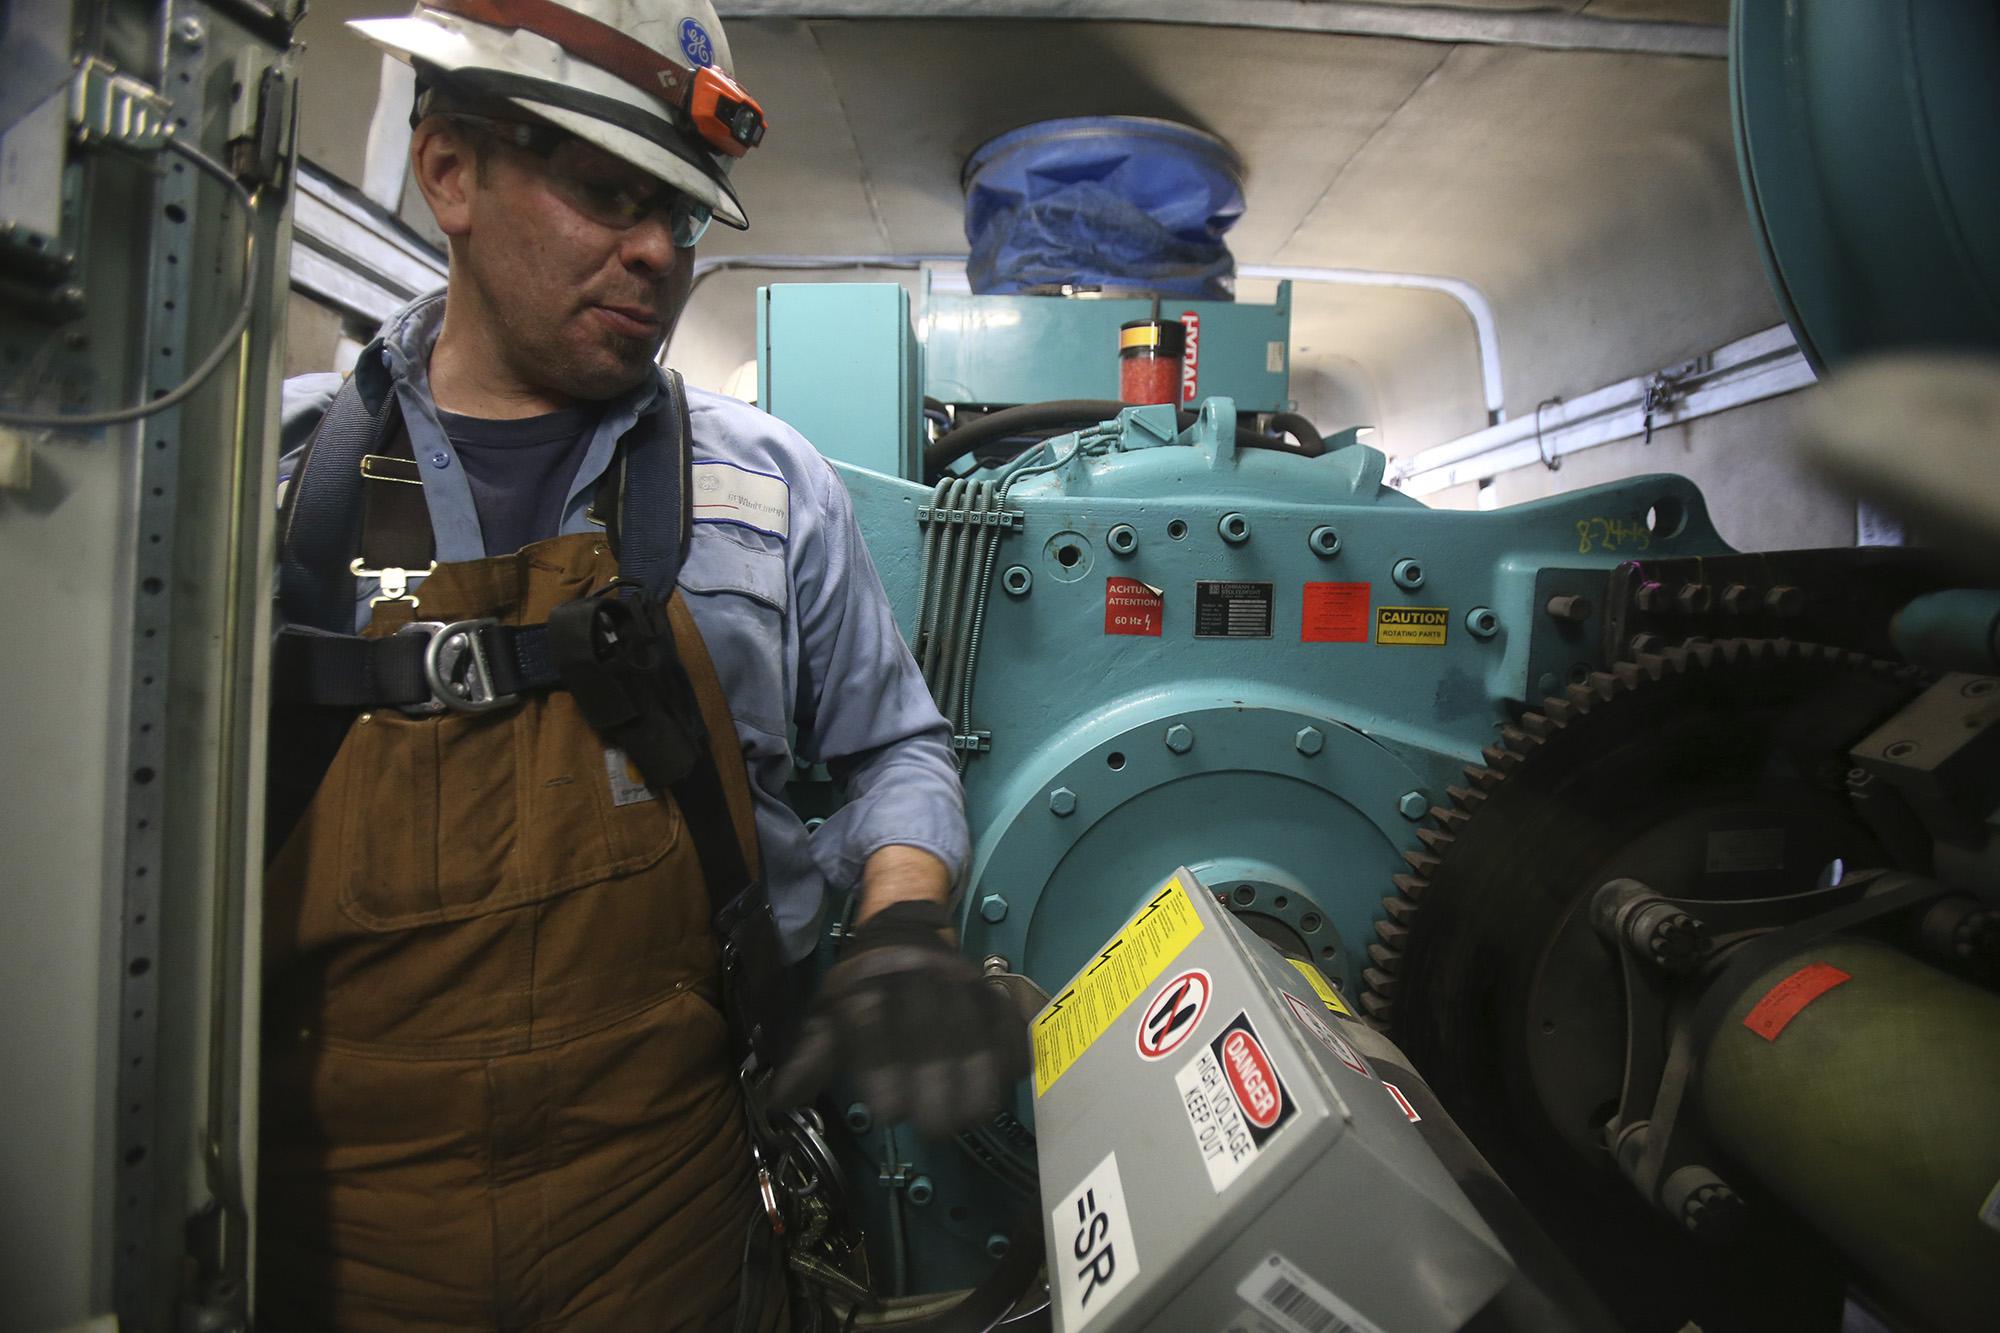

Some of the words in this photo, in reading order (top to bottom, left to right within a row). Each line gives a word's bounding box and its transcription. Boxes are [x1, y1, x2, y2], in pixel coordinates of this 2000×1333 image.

[1109, 585, 1150, 595] ACHTUN
[1108, 597, 1161, 607] ATTENTION!
[1114, 616, 1127, 625] 60
[1129, 616, 1142, 625] Hz
[1381, 612, 1446, 624] CAUTION
[1383, 630, 1417, 638] ROTATING
[1227, 1034, 1276, 1119] DANGER
[1196, 1052, 1222, 1093] HIGH
[1211, 1086, 1250, 1164] VOLTAGE
[1184, 1085, 1211, 1125] KEEP
[1198, 1126, 1225, 1162] OUT
